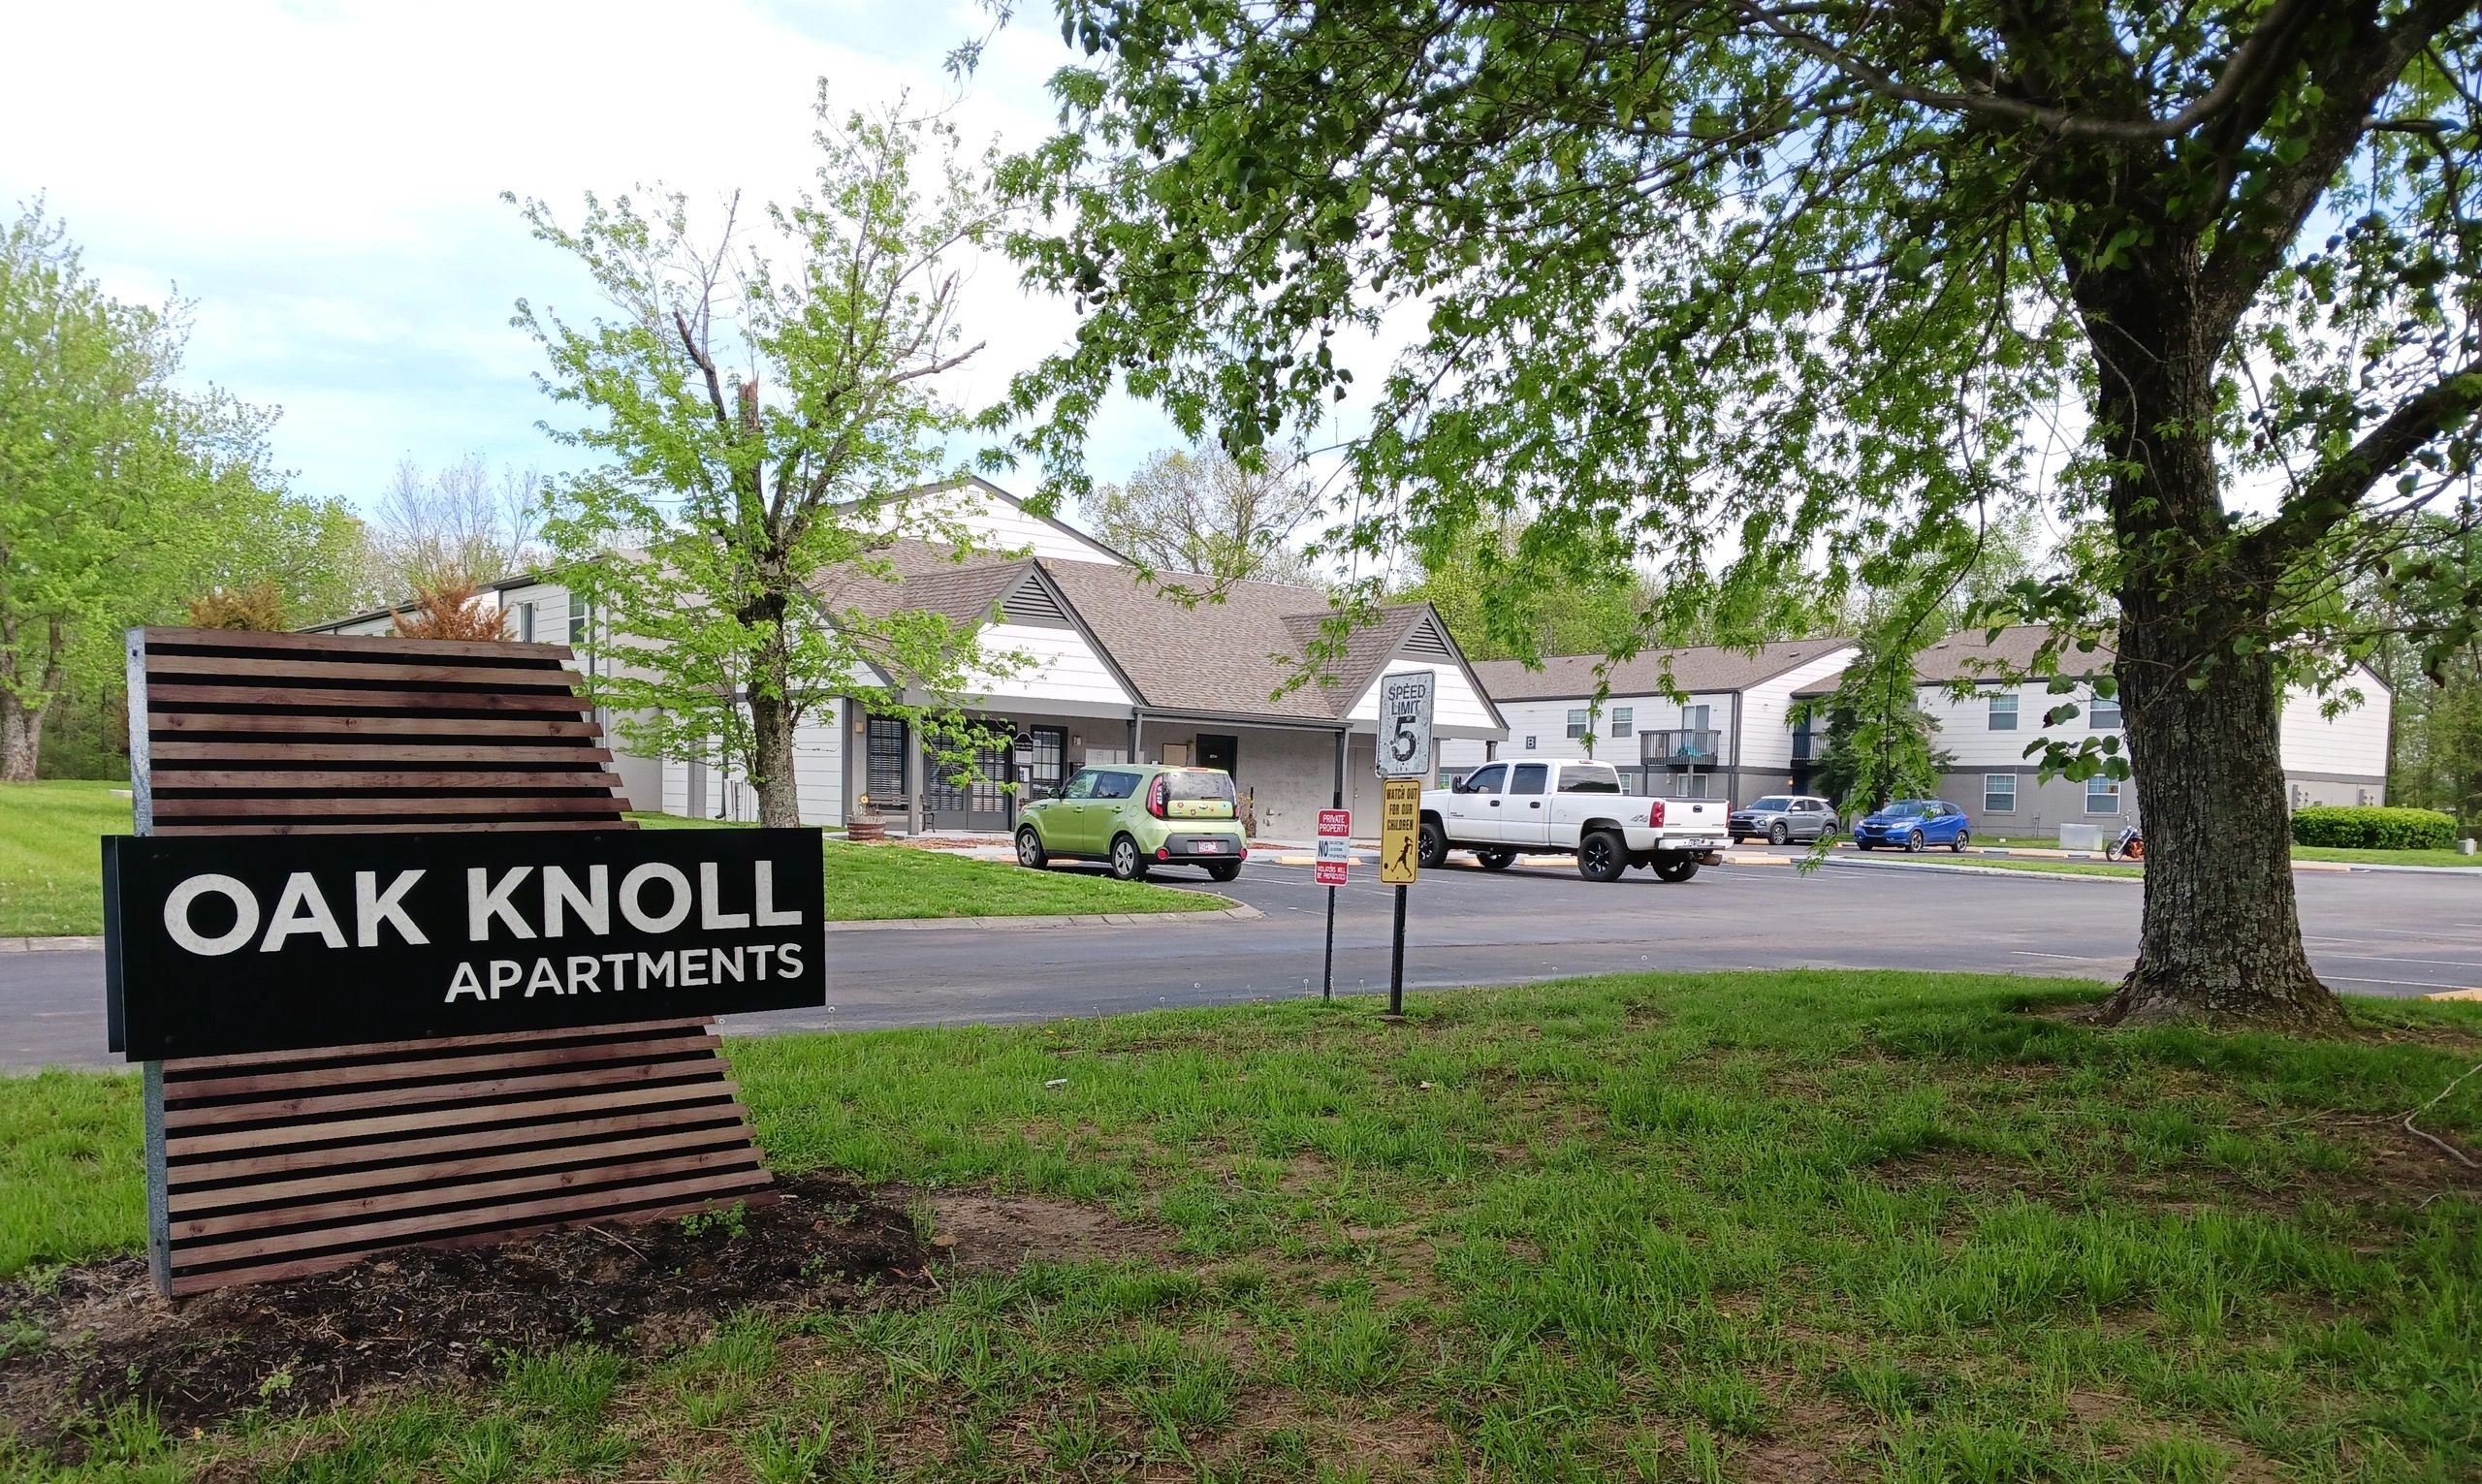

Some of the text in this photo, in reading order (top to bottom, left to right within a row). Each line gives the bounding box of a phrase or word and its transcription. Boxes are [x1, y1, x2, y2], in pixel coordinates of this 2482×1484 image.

[1388, 684, 1426, 701] SPEED
[1391, 700, 1421, 715] LIMIT
[1391, 715, 1416, 762] 5
[1527, 738, 1535, 747] B
[1386, 787, 1417, 800] WATCH OUT
[1389, 804, 1413, 815] FOR OUR
[1323, 814, 1346, 823] PRIVATE
[1387, 819, 1414, 831] CHILDREN
[1320, 824, 1348, 833] PROPERTY
[1319, 840, 1328, 857] NO
[163, 860, 803, 957] OAK KNOLL
[445, 943, 804, 1004] APARTMENTS
